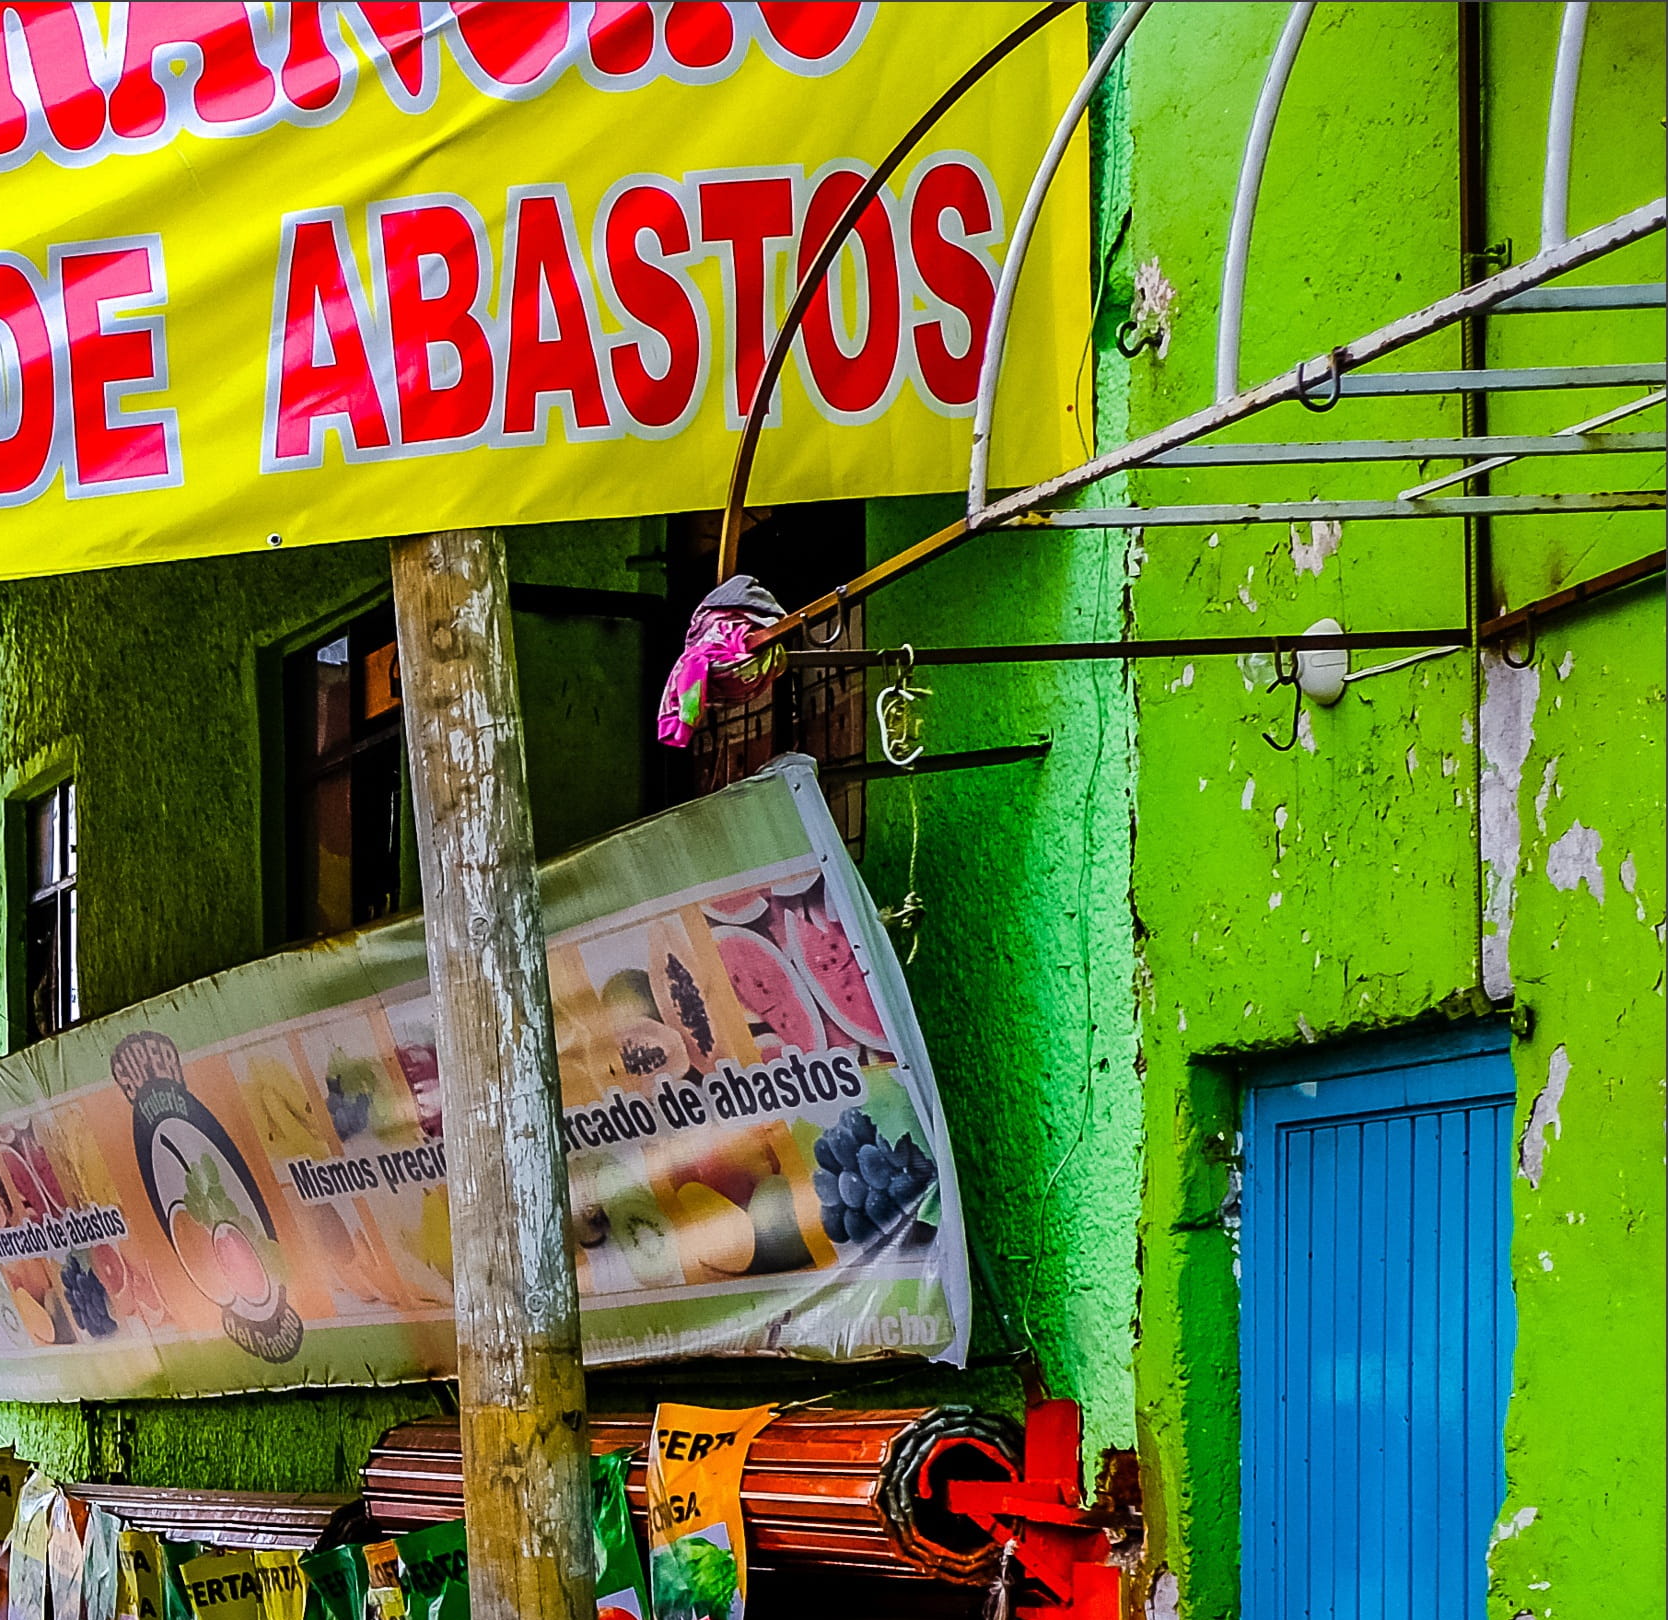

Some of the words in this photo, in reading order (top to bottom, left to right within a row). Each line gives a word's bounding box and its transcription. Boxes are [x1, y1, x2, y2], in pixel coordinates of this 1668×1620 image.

[262, 150, 1006, 473] ABASTOS
[113, 1038, 182, 1101] SUPER
[288, 1158, 379, 1201] Mismos
[660, 1080, 706, 1130] de
[708, 1054, 862, 1119] abastos
[44, 1217, 66, 1249] de
[64, 1205, 127, 1244] abastos
[224, 1316, 257, 1352] del
[253, 1307, 301, 1359] Rancho
